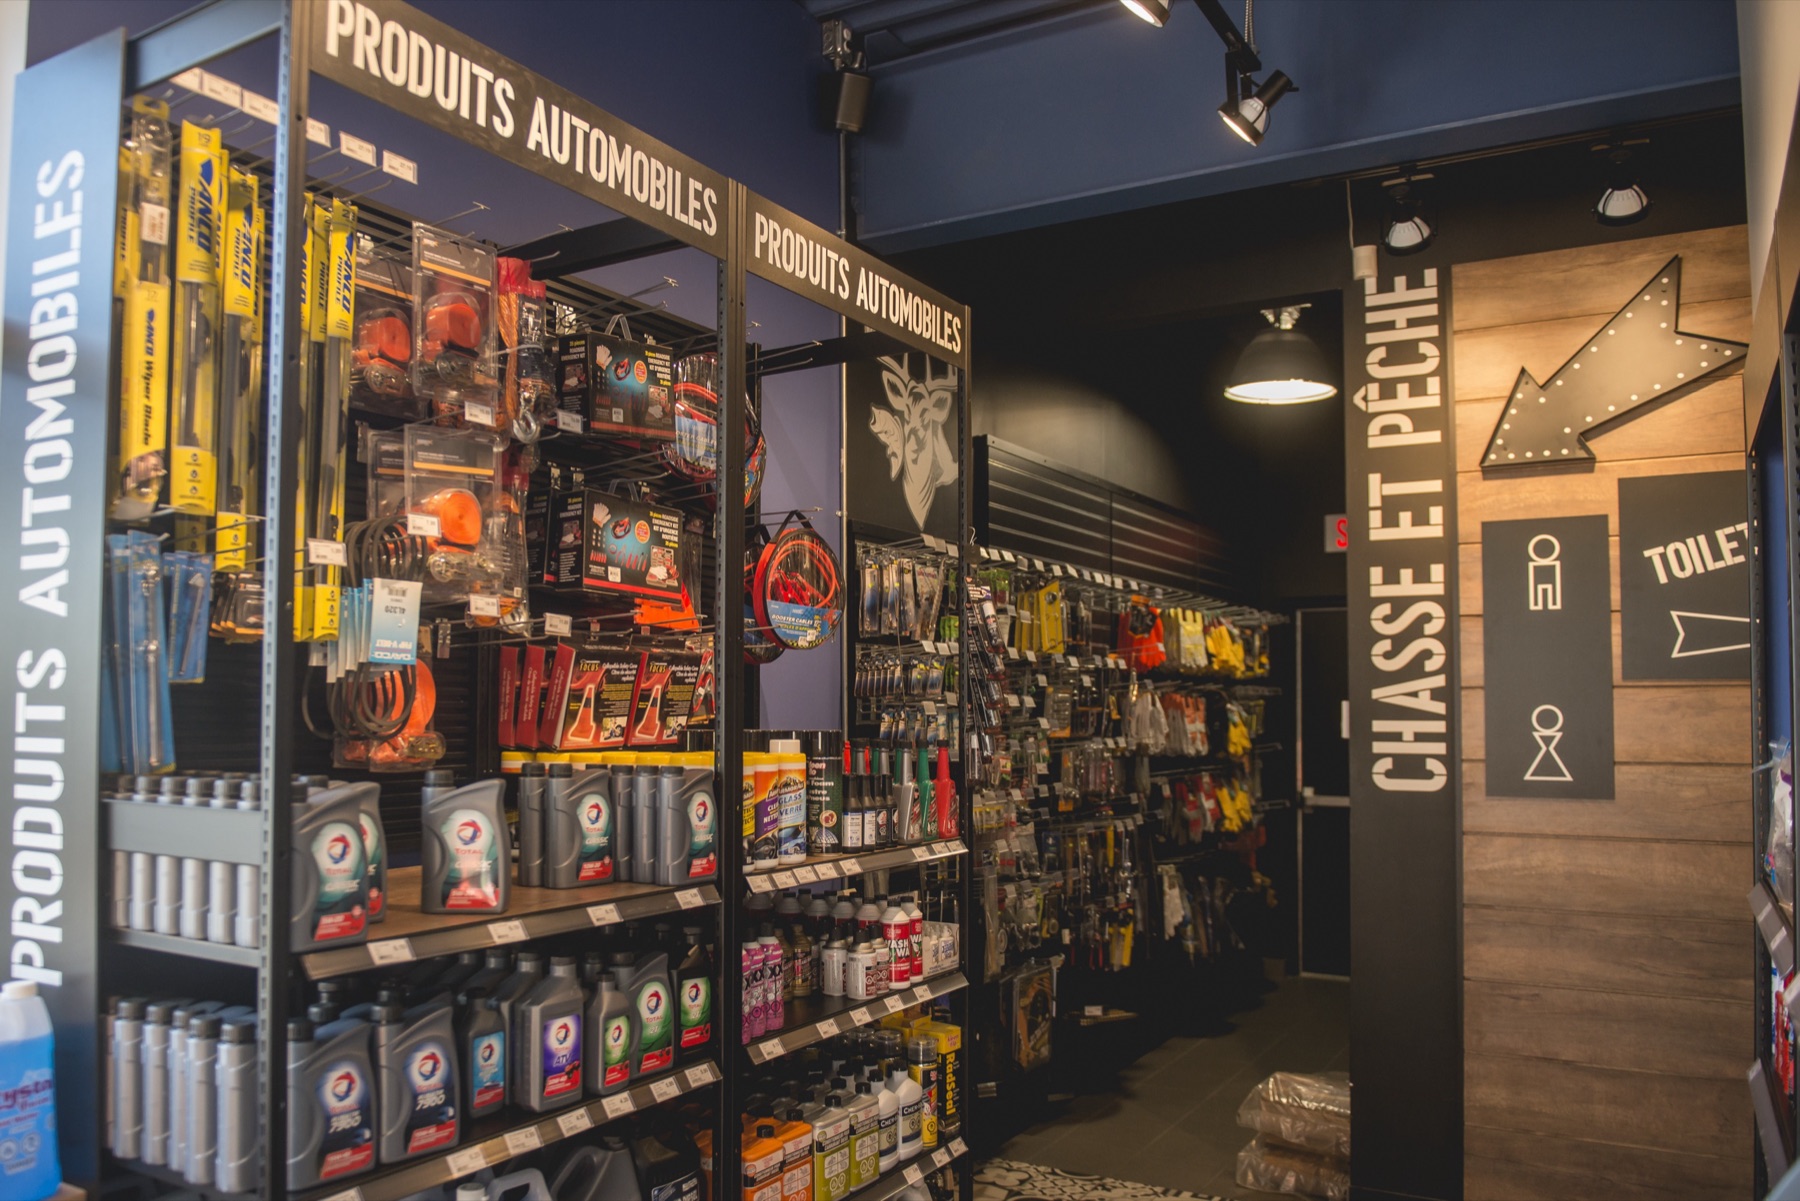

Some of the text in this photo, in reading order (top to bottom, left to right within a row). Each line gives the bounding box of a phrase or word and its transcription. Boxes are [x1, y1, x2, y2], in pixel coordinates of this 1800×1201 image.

[326, 0, 718, 237] PRODUITS AUTOMOBILES
[342, 250, 353, 314] ANCO
[754, 211, 962, 354] PRODUITS AUTOMOBILES
[142, 320, 155, 447] ANCO Wiper Blade
[1352, 267, 1448, 793] CHASSE ET PÊCHE
[11, 149, 86, 988] PRODUITS AUTOMOBILES
[771, 613, 813, 625] BOOSTER CABLES
[580, 663, 599, 672] FOCUS
[649, 664, 667, 673] FOCUS
[779, 792, 802, 804] GLASS
[779, 804, 802, 817] VERRE
[645, 1015, 663, 1024] TOTAL
[553, 1053, 571, 1068] ATV
[945, 1051, 957, 1116] RadSeal
